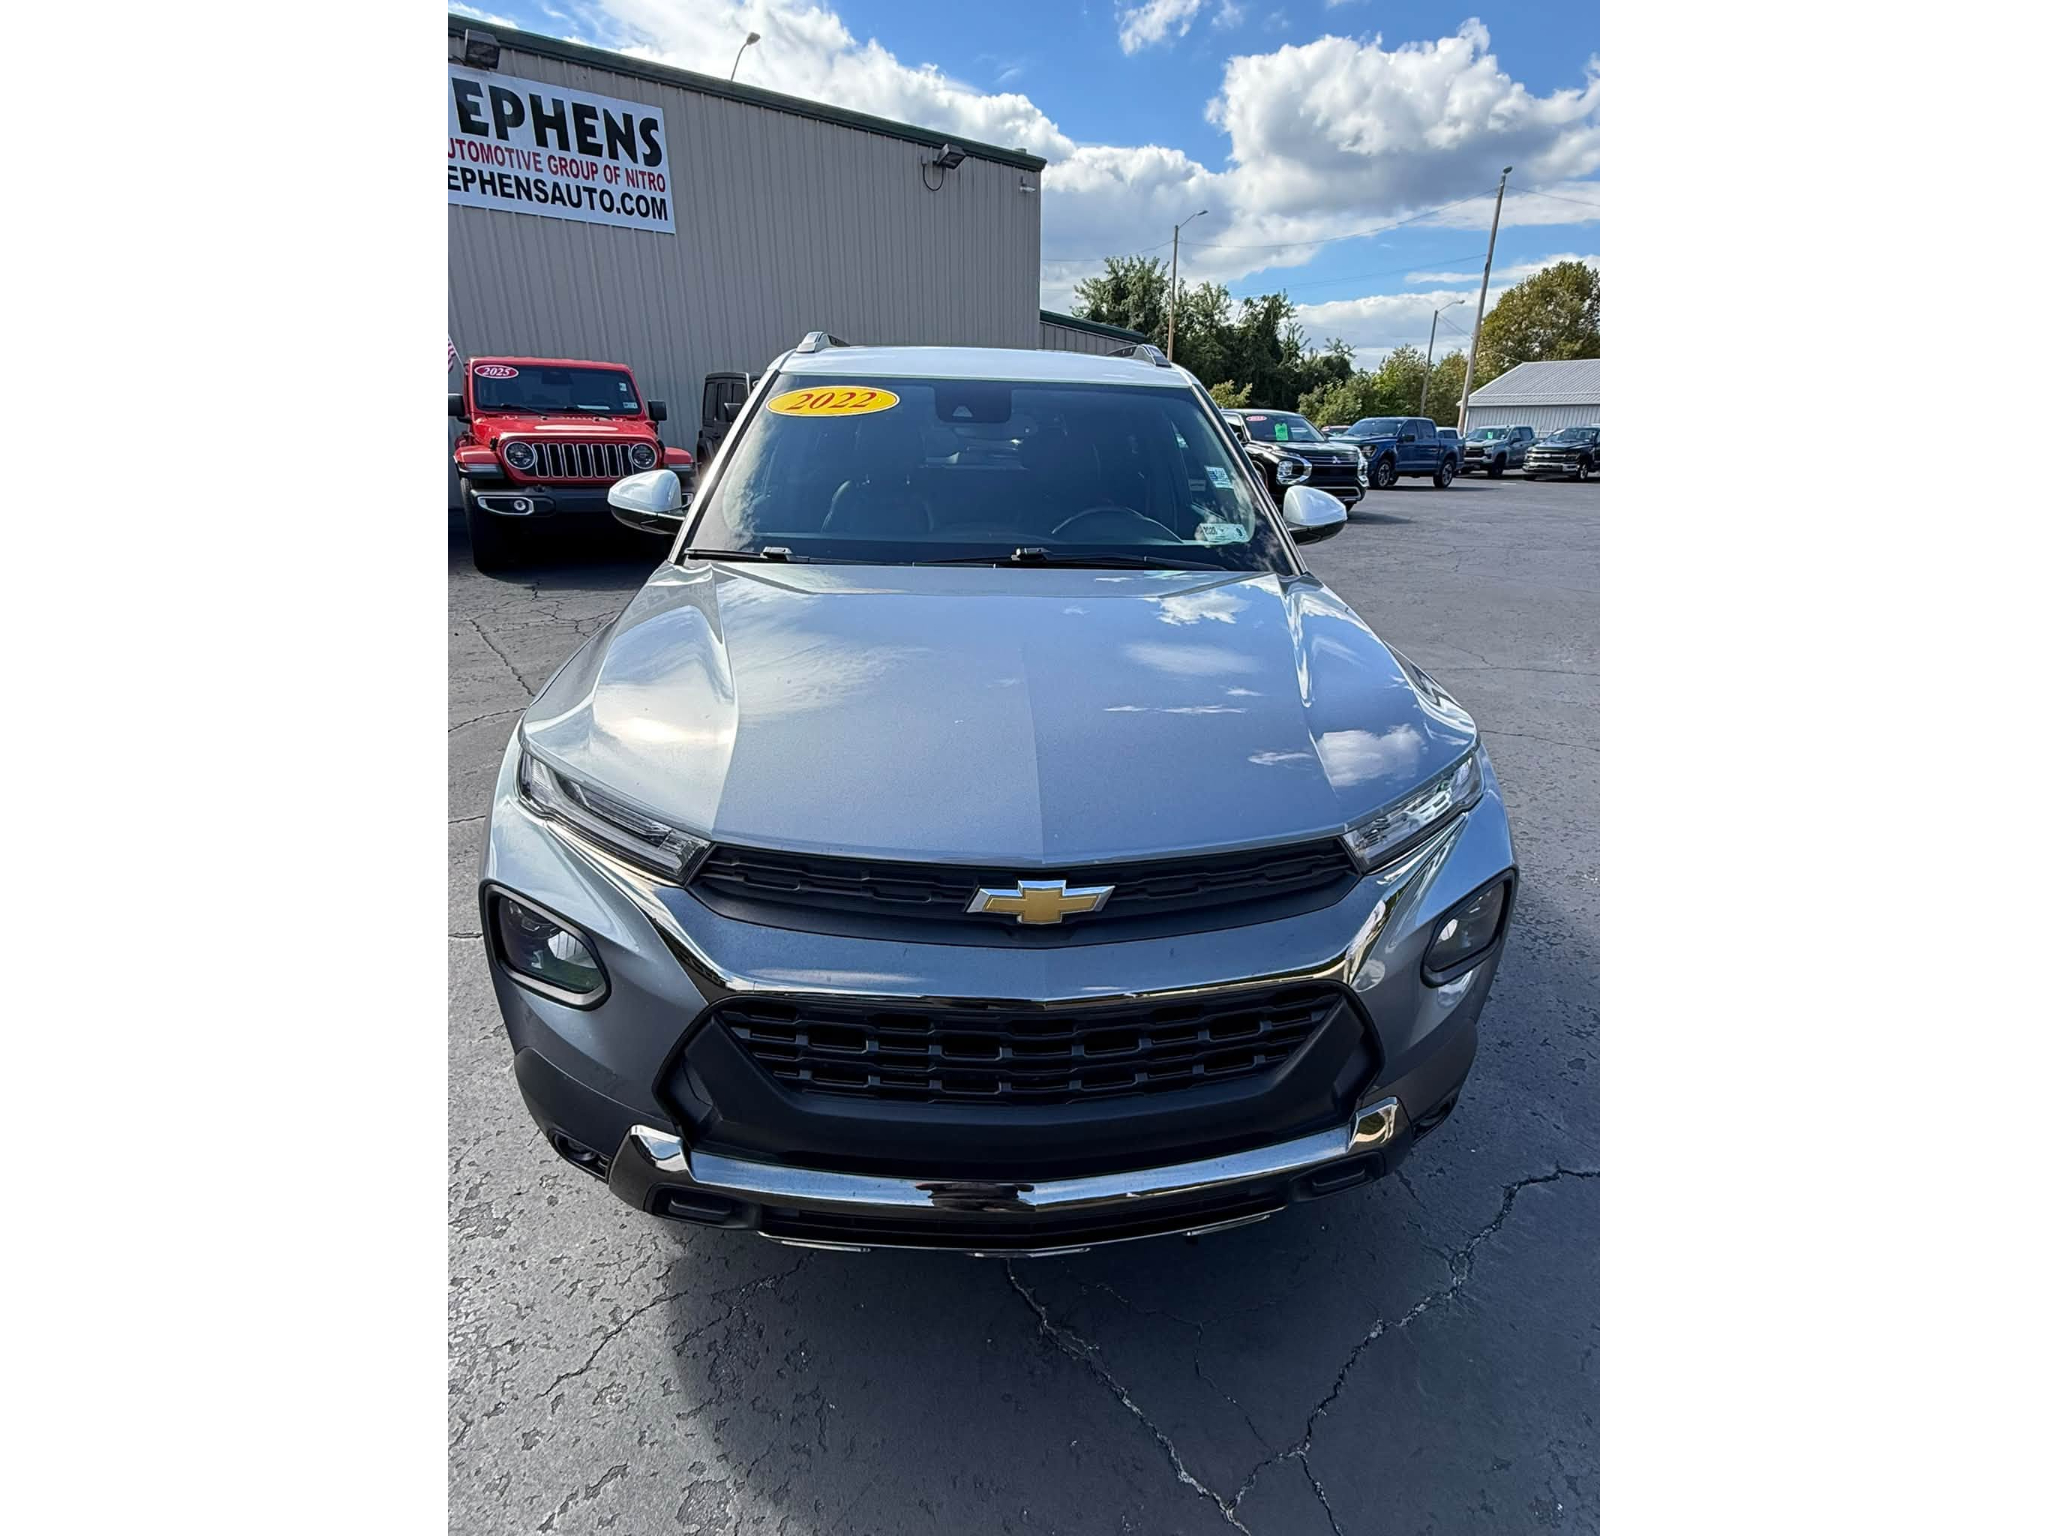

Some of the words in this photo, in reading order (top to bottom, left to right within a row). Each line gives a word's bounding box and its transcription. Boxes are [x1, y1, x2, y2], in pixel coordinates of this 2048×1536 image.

[452, 77, 662, 167] EPHENS
[547, 155, 598, 181] GROUP
[603, 164, 620, 185] OF
[625, 167, 666, 192] NITRO
[448, 165, 668, 221] EPHENSAUTO.COM
[482, 367, 510, 376] 2025
[785, 391, 877, 410] 2022
